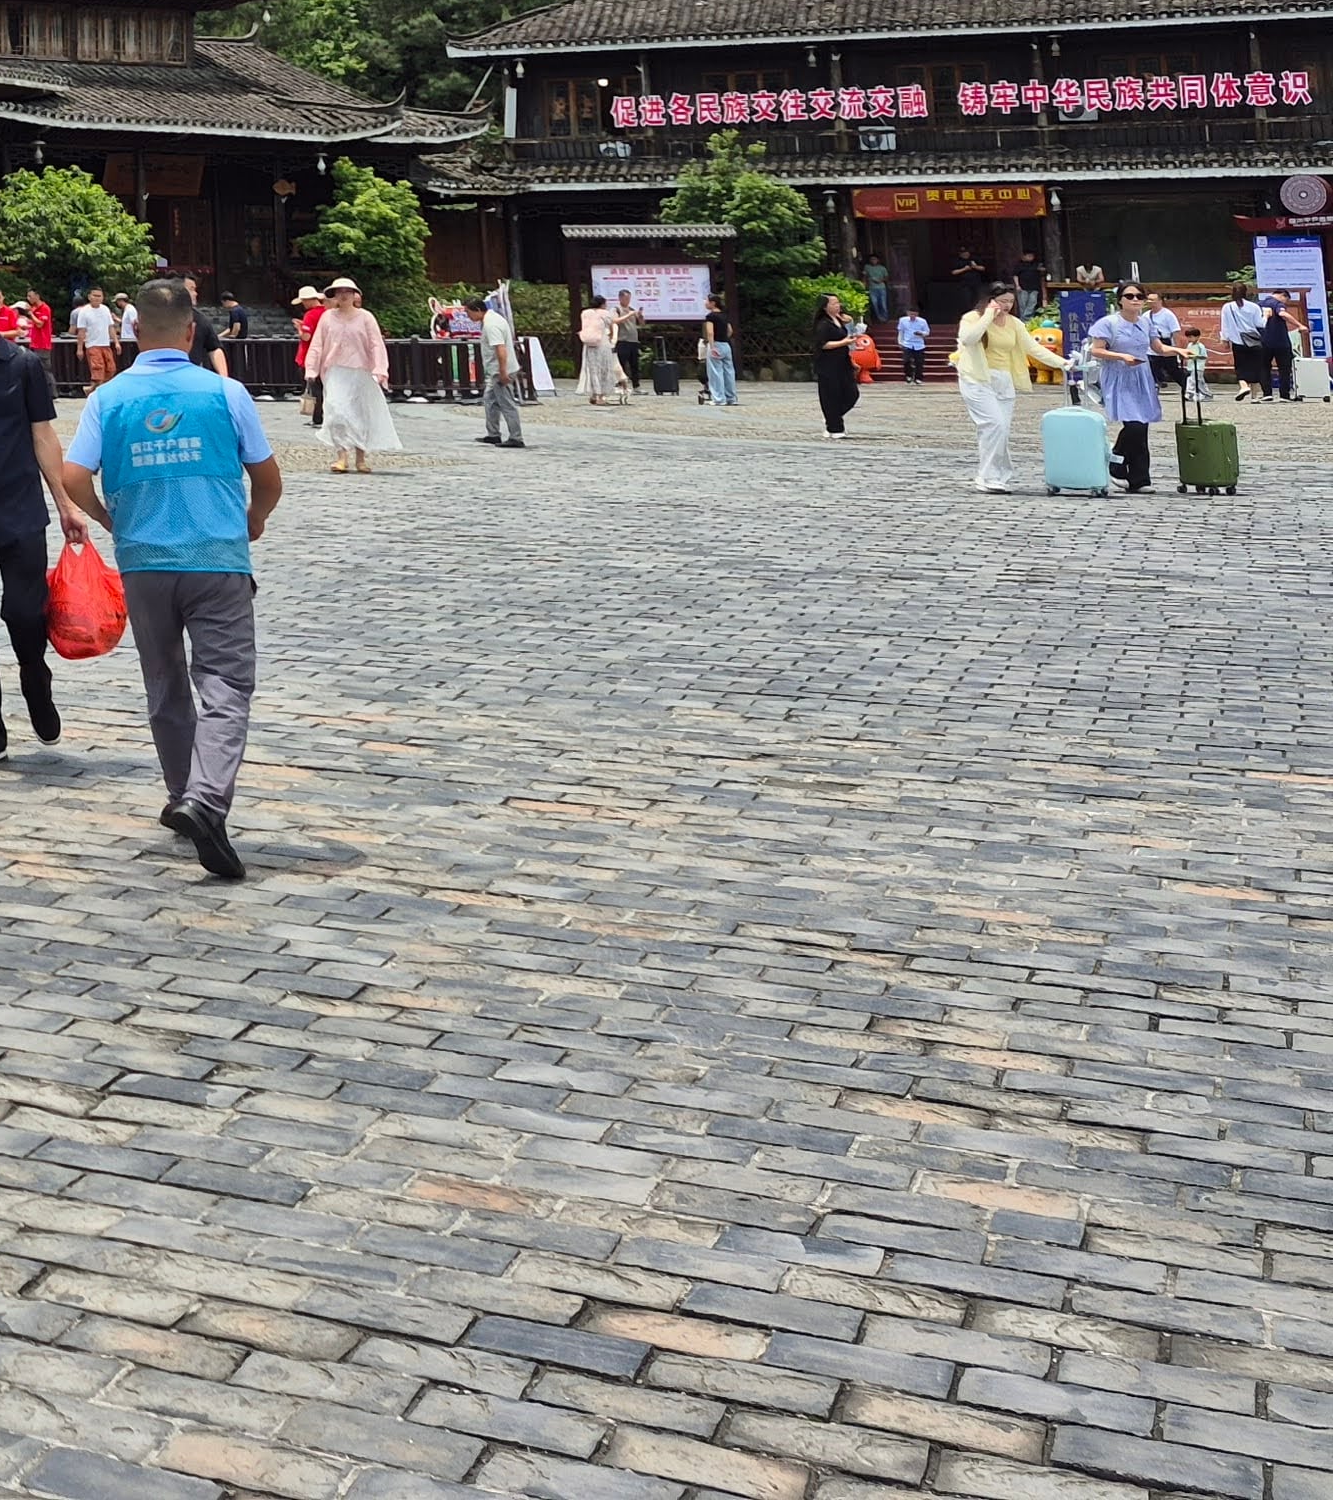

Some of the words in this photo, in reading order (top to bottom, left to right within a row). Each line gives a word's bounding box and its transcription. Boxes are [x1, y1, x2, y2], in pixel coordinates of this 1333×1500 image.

[610, 83, 929, 128] 促进各民族交往交流交融
[957, 70, 1313, 116] 铸牢中华民族共同体意识
